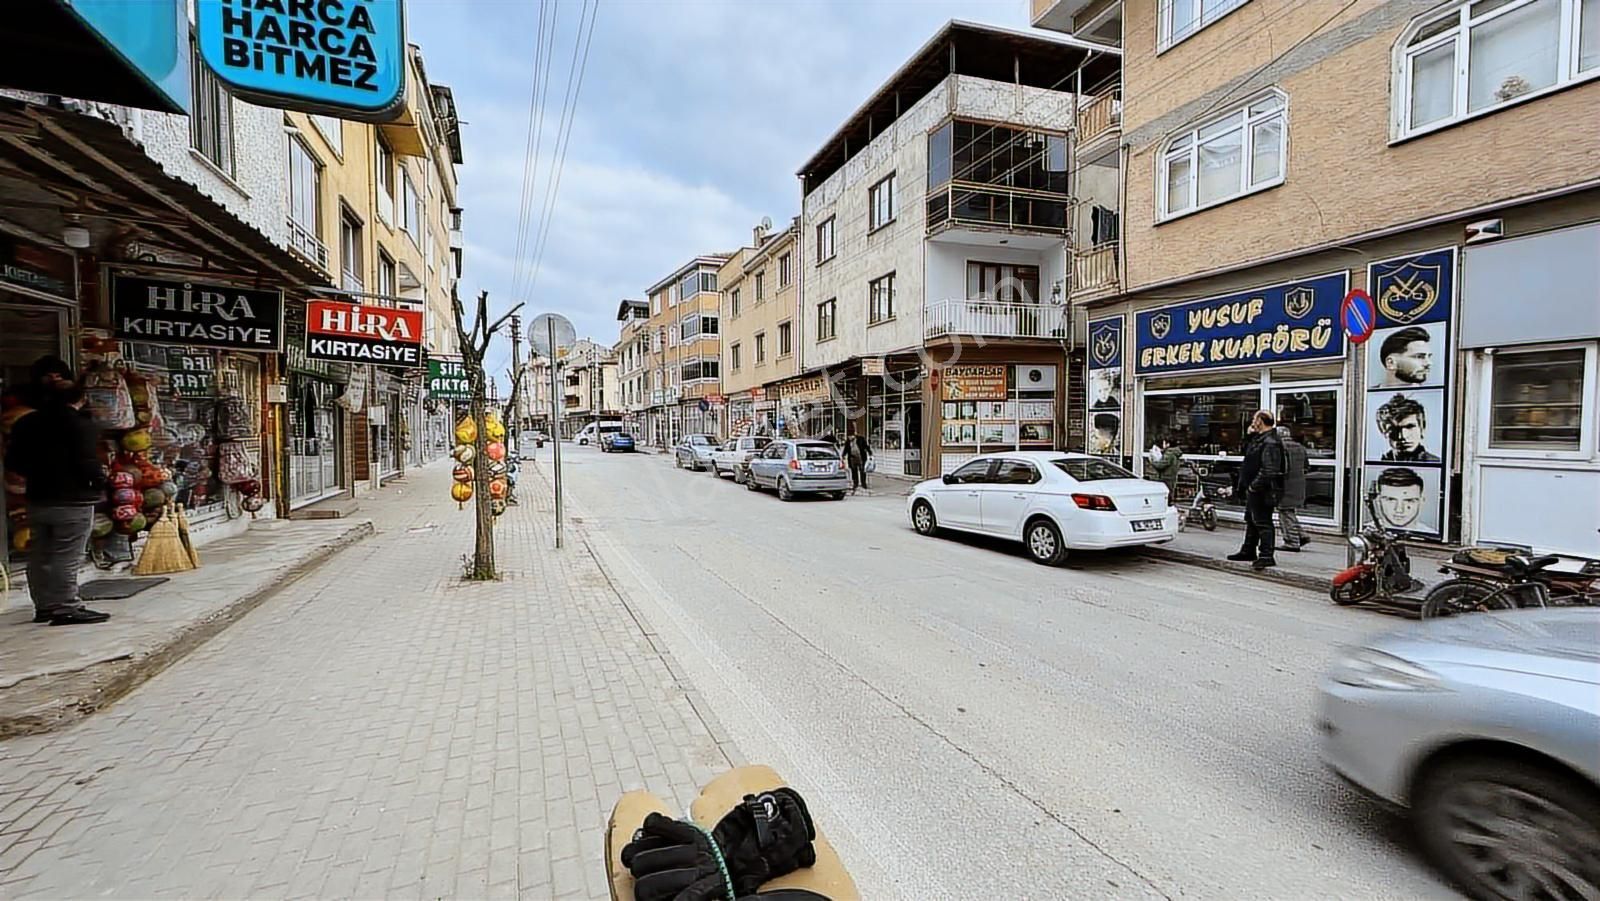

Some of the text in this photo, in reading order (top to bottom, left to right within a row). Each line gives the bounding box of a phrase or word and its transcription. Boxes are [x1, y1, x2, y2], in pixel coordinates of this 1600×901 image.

[222, 0, 376, 33] ARCA
[222, 6, 376, 62] HARCA
[1188, 299, 1264, 334] YUSUF
[1141, 341, 1205, 368] ERKEK
[1210, 318, 1332, 361] KUAFÖRÜ
[431, 378, 469, 392] AKTA
